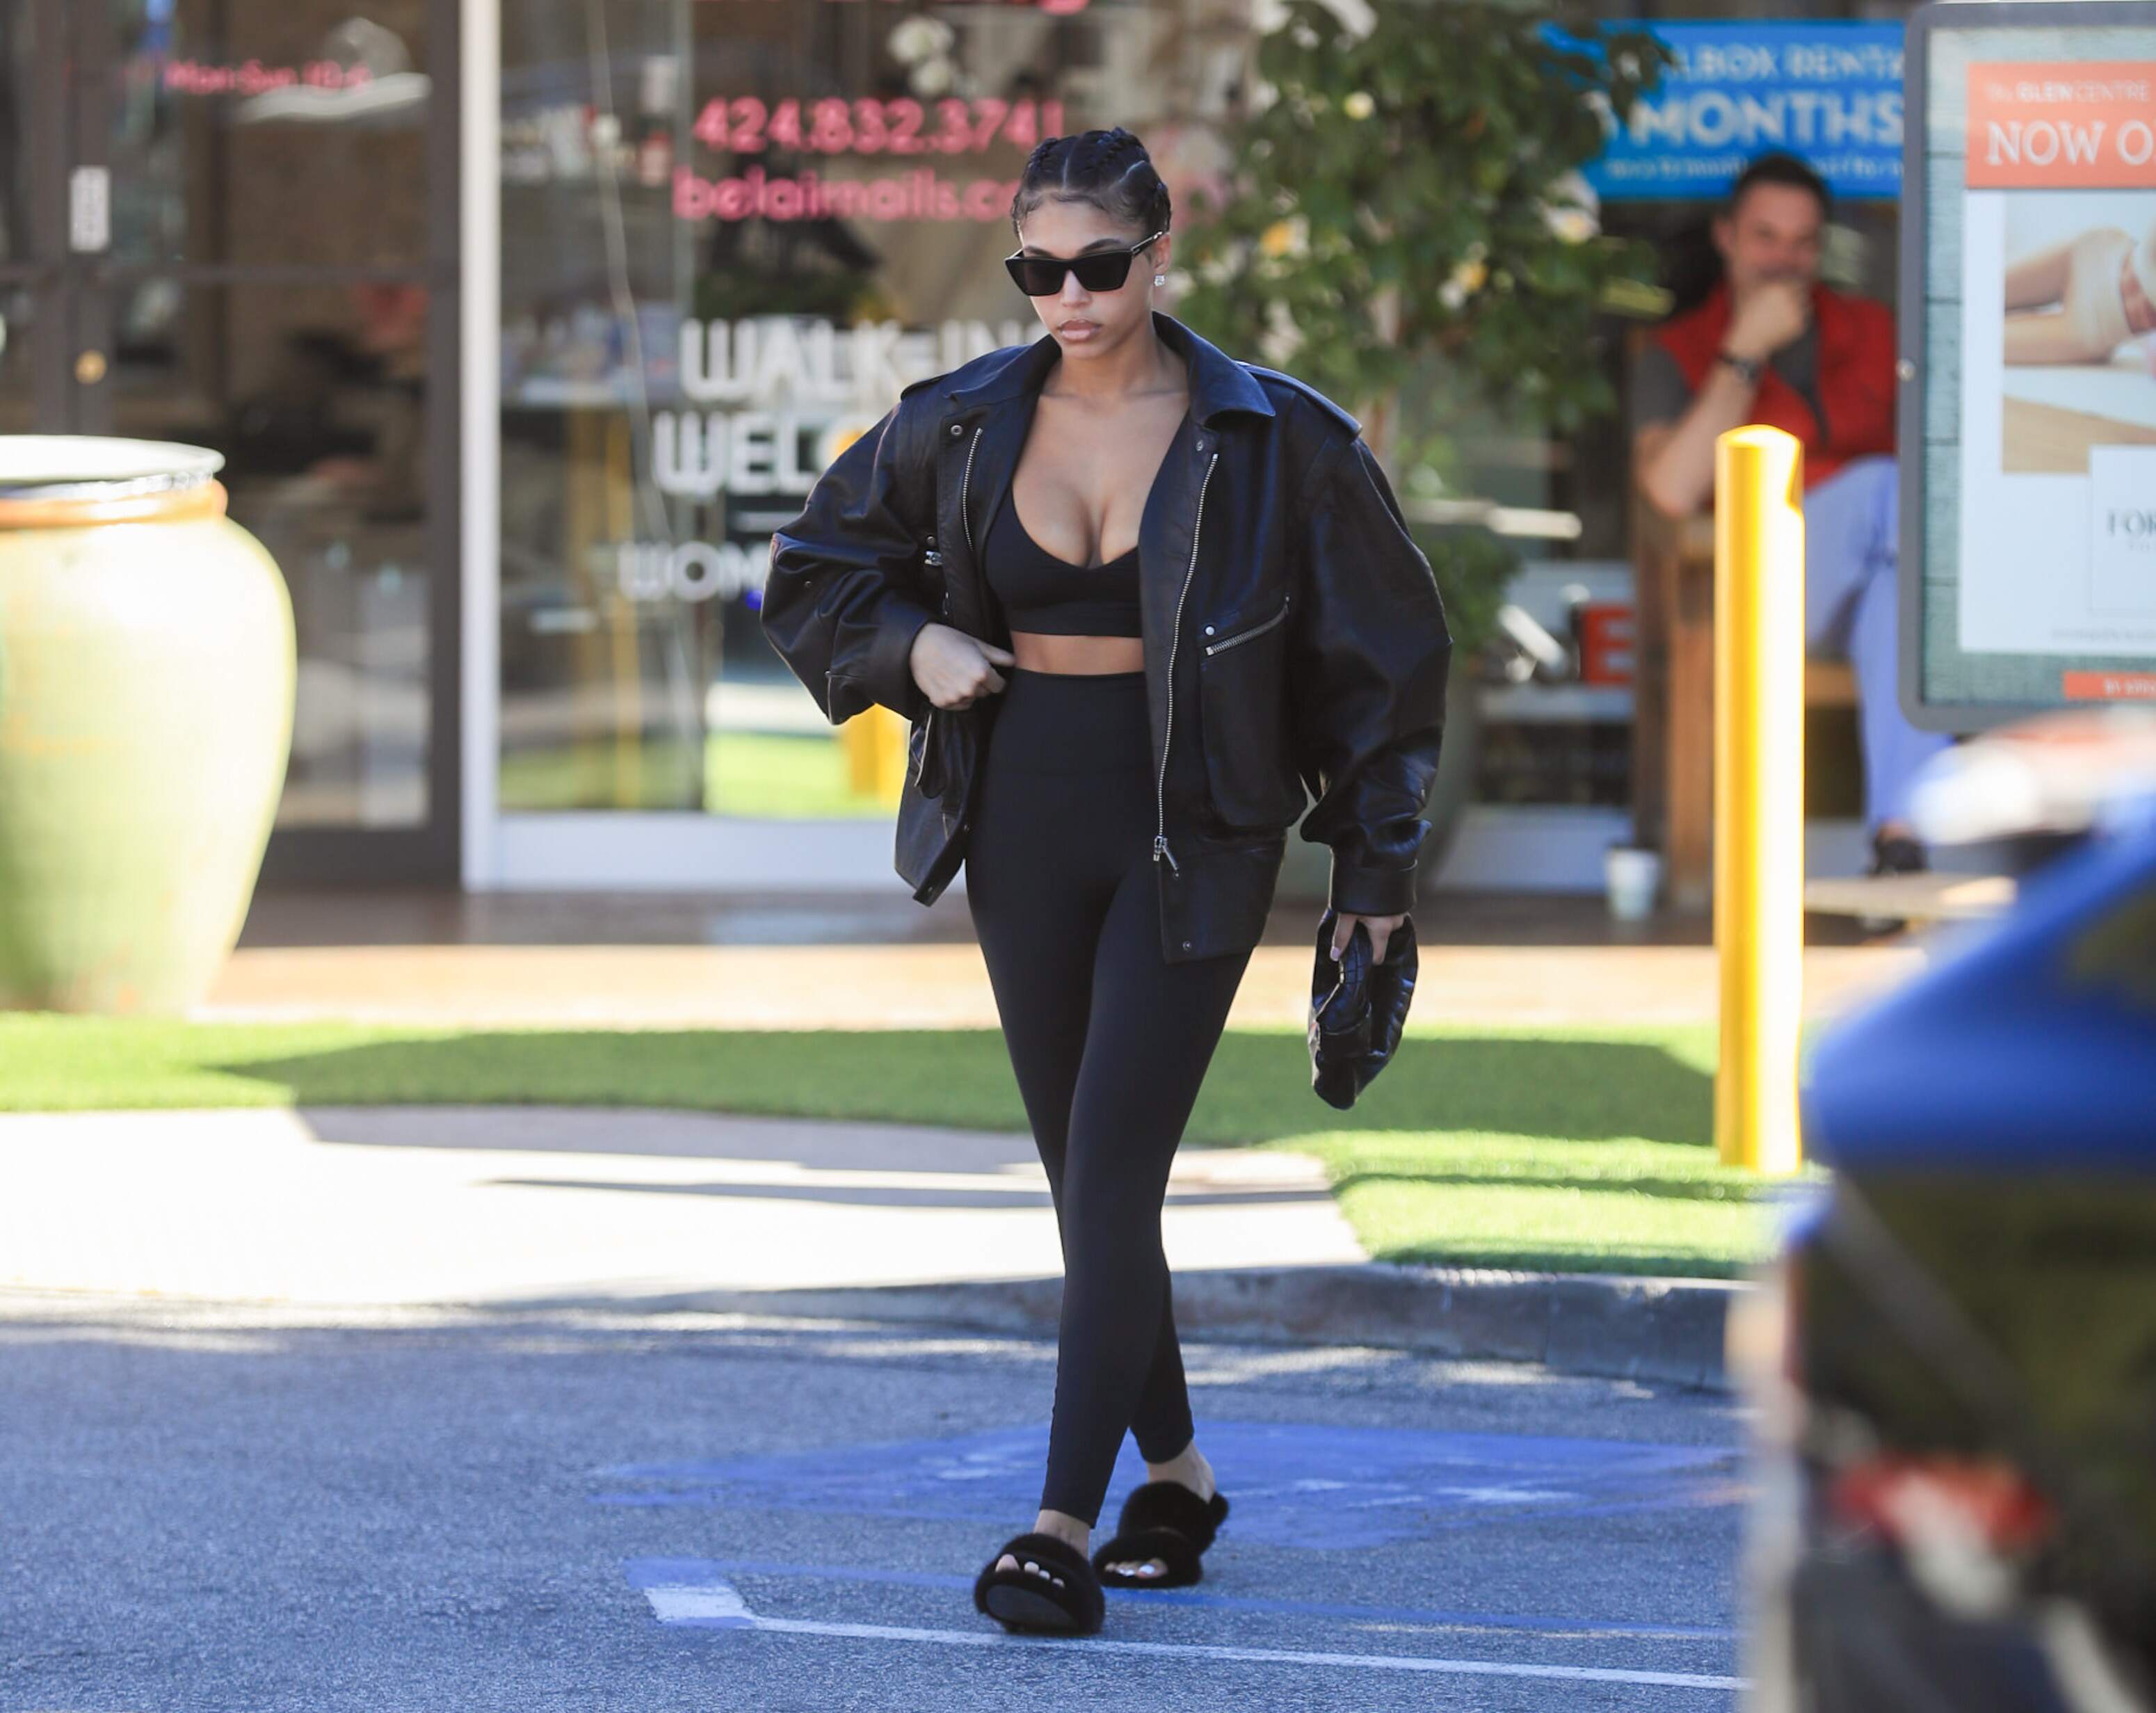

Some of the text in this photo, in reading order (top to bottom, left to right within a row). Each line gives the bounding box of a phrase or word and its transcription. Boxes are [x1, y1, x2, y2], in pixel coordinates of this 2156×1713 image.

[693, 96, 1064, 154] 424.832.3741
[1627, 90, 1905, 147] MONTHS
[1987, 119, 2156, 166] NOW O
